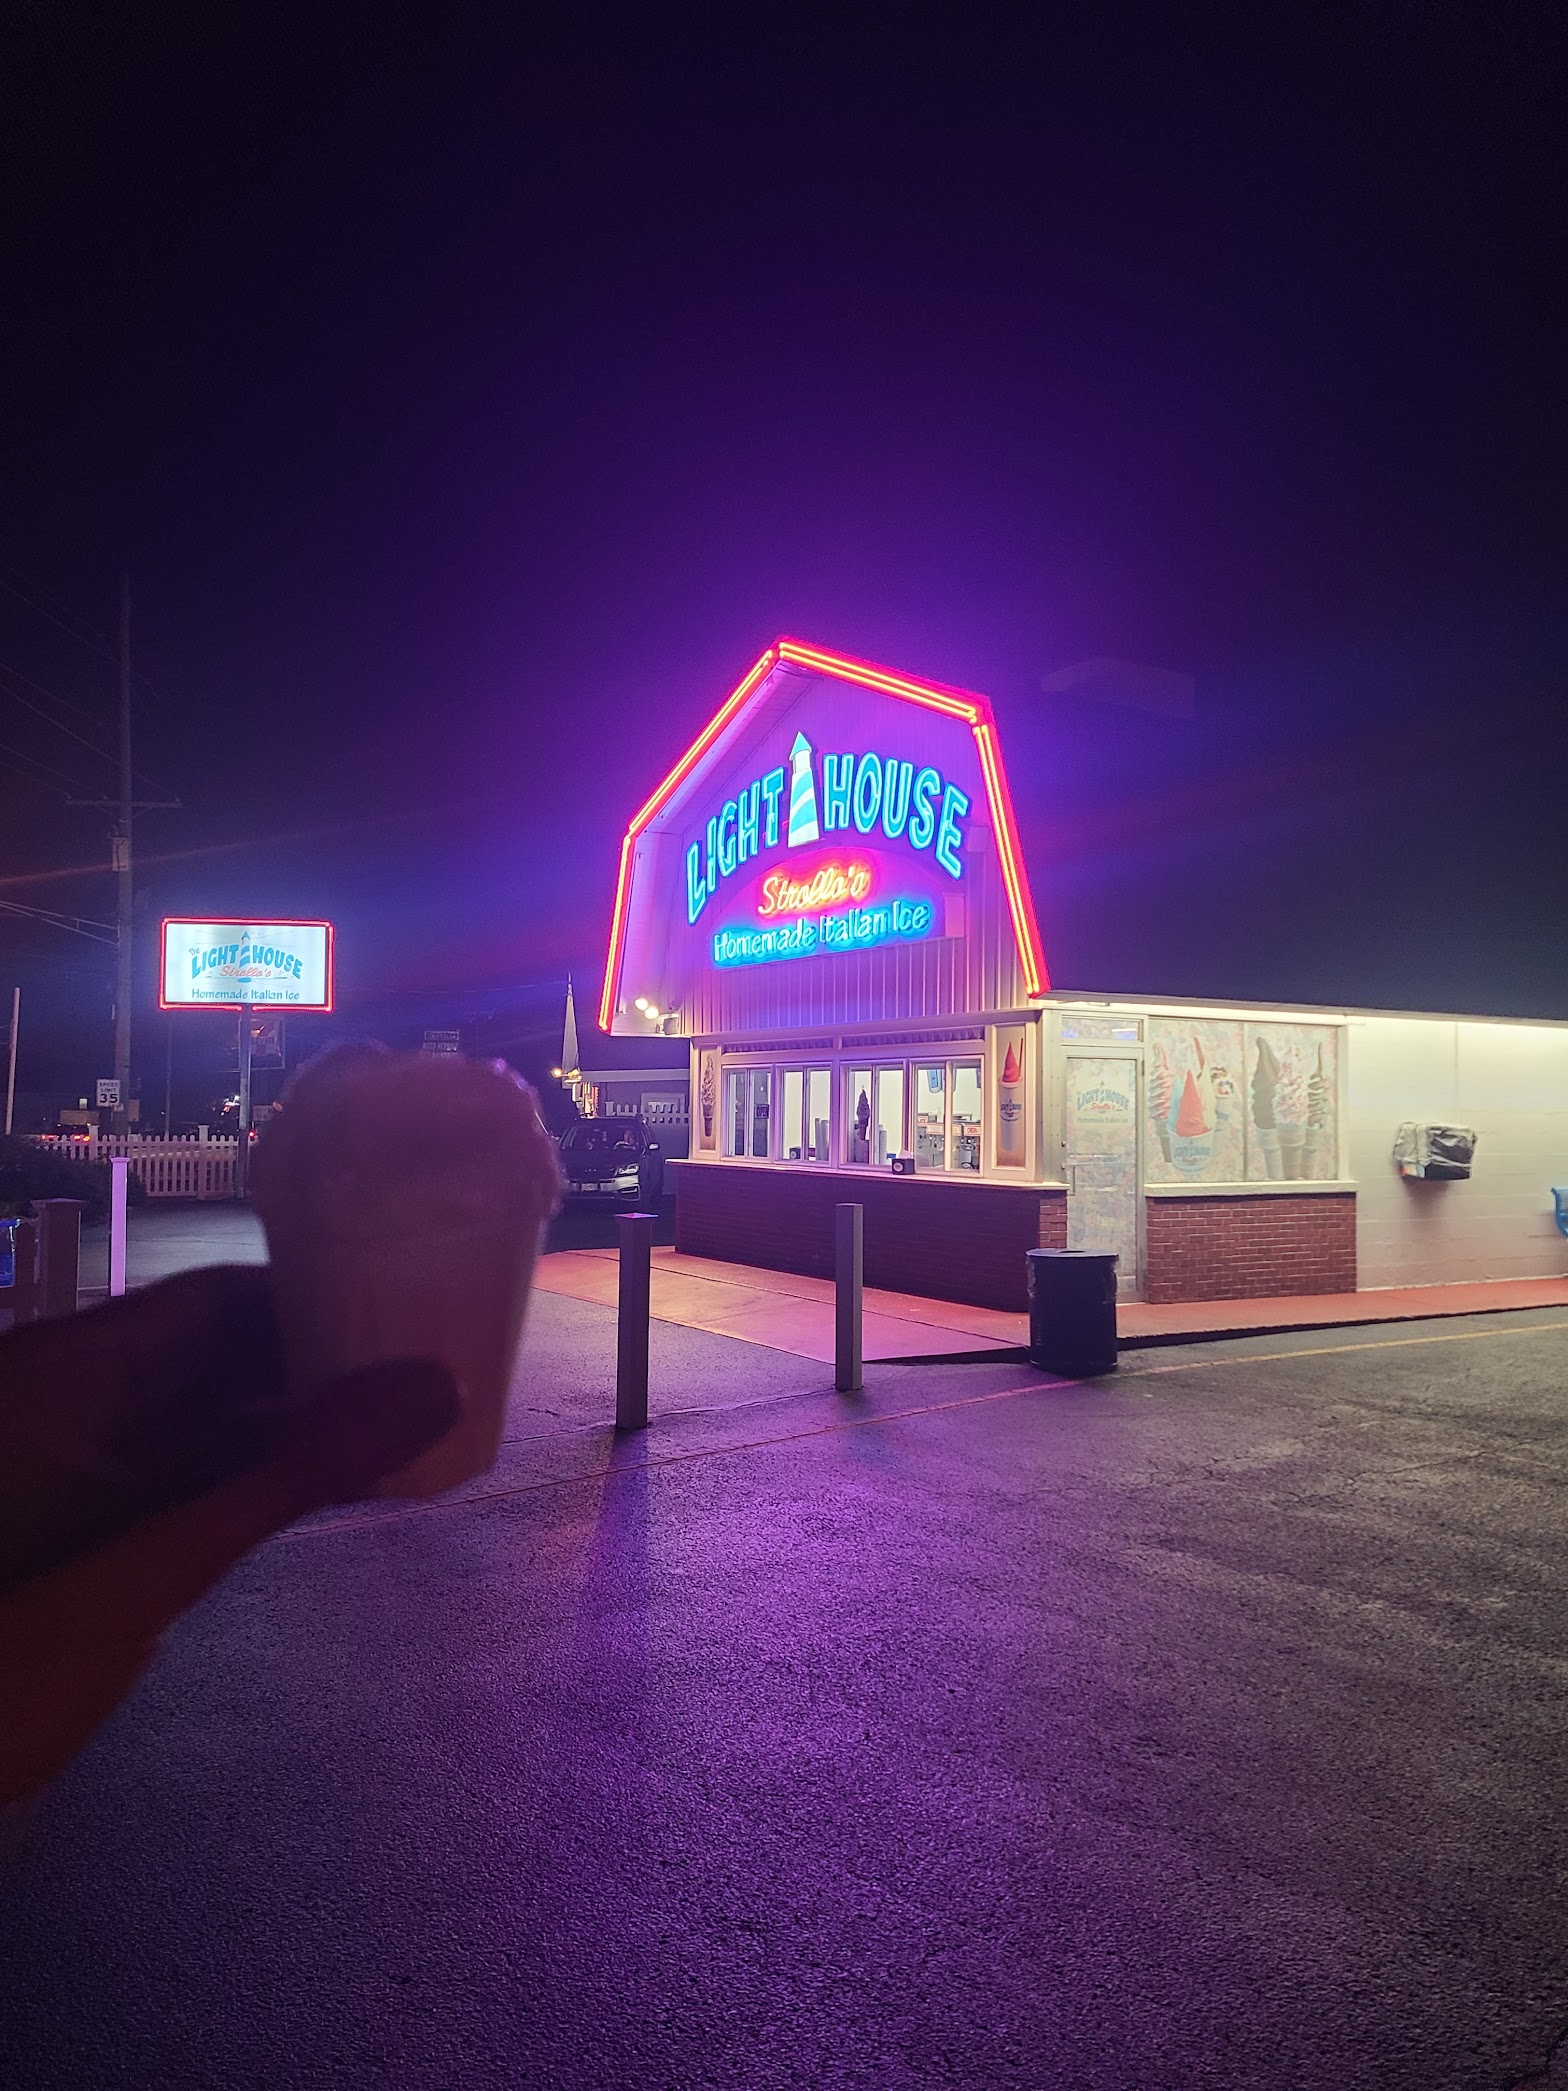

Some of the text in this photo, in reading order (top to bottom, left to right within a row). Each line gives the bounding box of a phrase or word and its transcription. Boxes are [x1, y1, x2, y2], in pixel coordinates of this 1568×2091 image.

[685, 751, 970, 926] LIGHT HOUSE
[757, 864, 870, 916] Strollo's
[713, 900, 929, 961] Homemade Italian Ice
[188, 946, 200, 955] The
[191, 944, 303, 979] LIGHT HOUSE
[219, 965, 272, 977] Strollo's
[191, 988, 300, 1000] Homemade Italian Ice
[99, 1093, 118, 1103] 35
